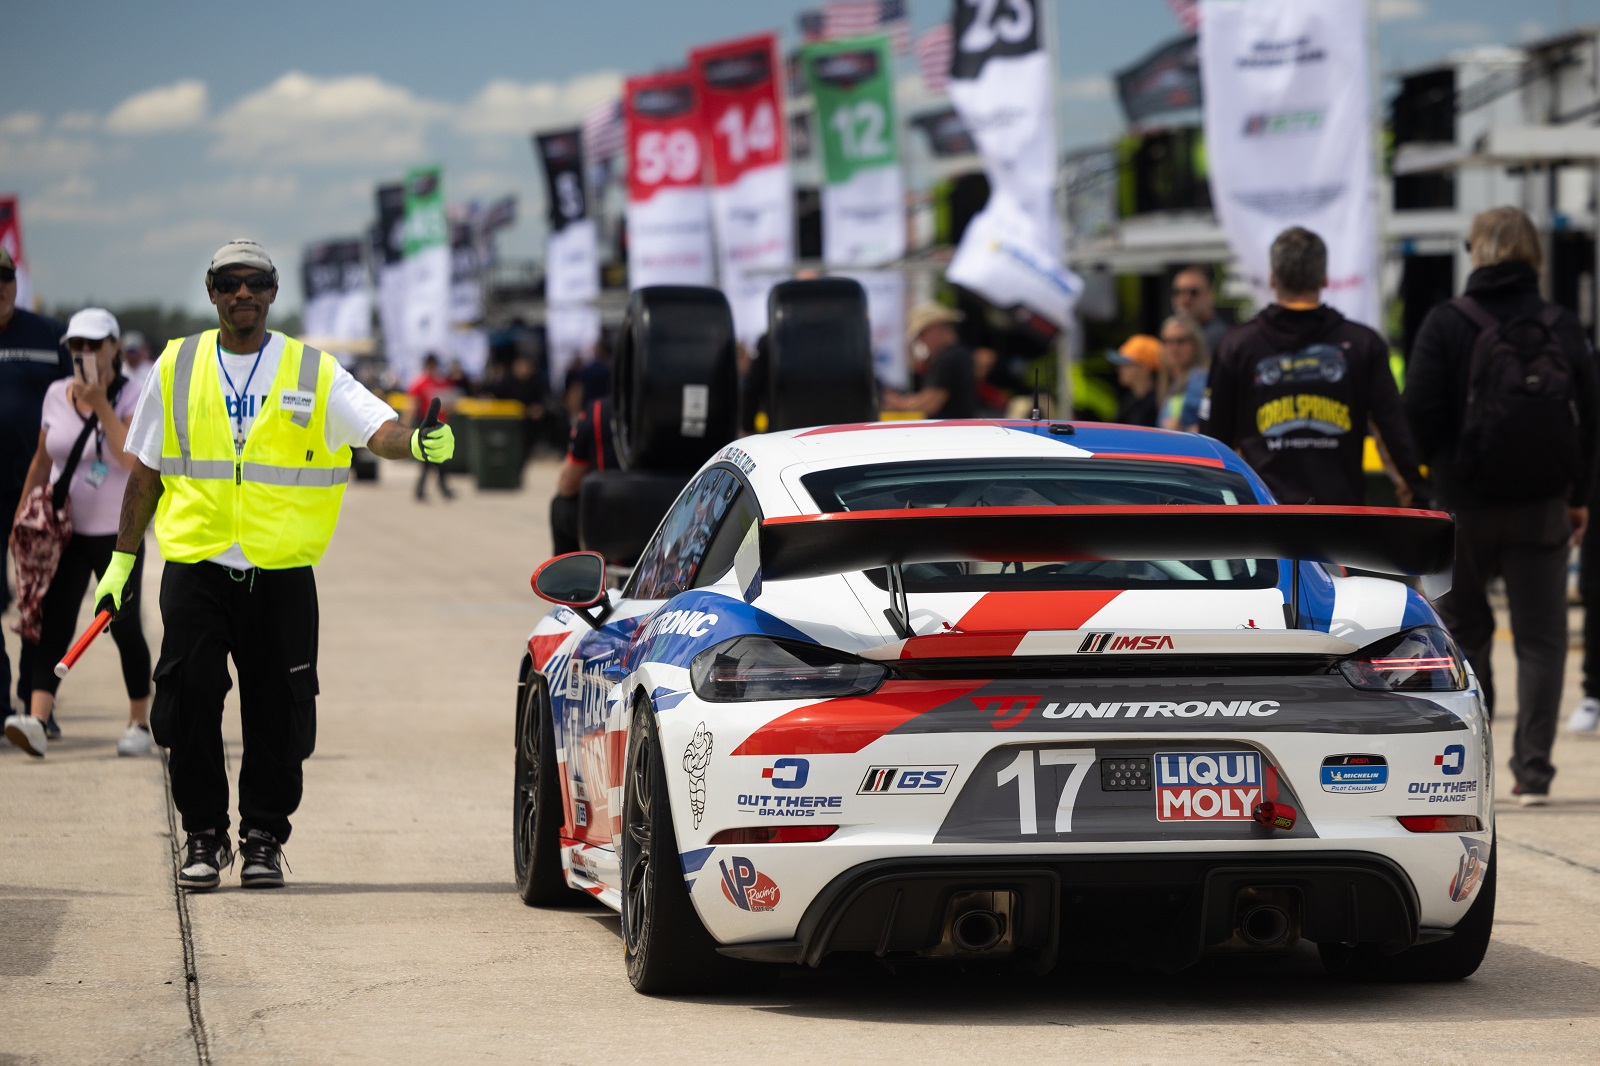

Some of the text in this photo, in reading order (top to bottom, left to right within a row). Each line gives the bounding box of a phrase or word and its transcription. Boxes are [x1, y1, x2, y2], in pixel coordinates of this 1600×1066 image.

[715, 101, 777, 163] 14
[831, 102, 888, 159] 12
[636, 128, 700, 185] 59
[1110, 635, 1174, 651] IMSA
[1042, 700, 1281, 719] UNITRONIC
[1161, 755, 1256, 785] LIQUI
[1350, 757, 1370, 765] IMSA
[897, 771, 948, 789] GS
[1408, 780, 1477, 794] OUT THERE
[737, 794, 842, 808] OUT THERE
[996, 748, 1096, 835] 17
[1428, 794, 1467, 803] BRANDS
[758, 808, 816, 817] BRANDS
[1162, 788, 1262, 817] MOLY
[718, 855, 757, 912] VP
[747, 885, 779, 906] Racing
